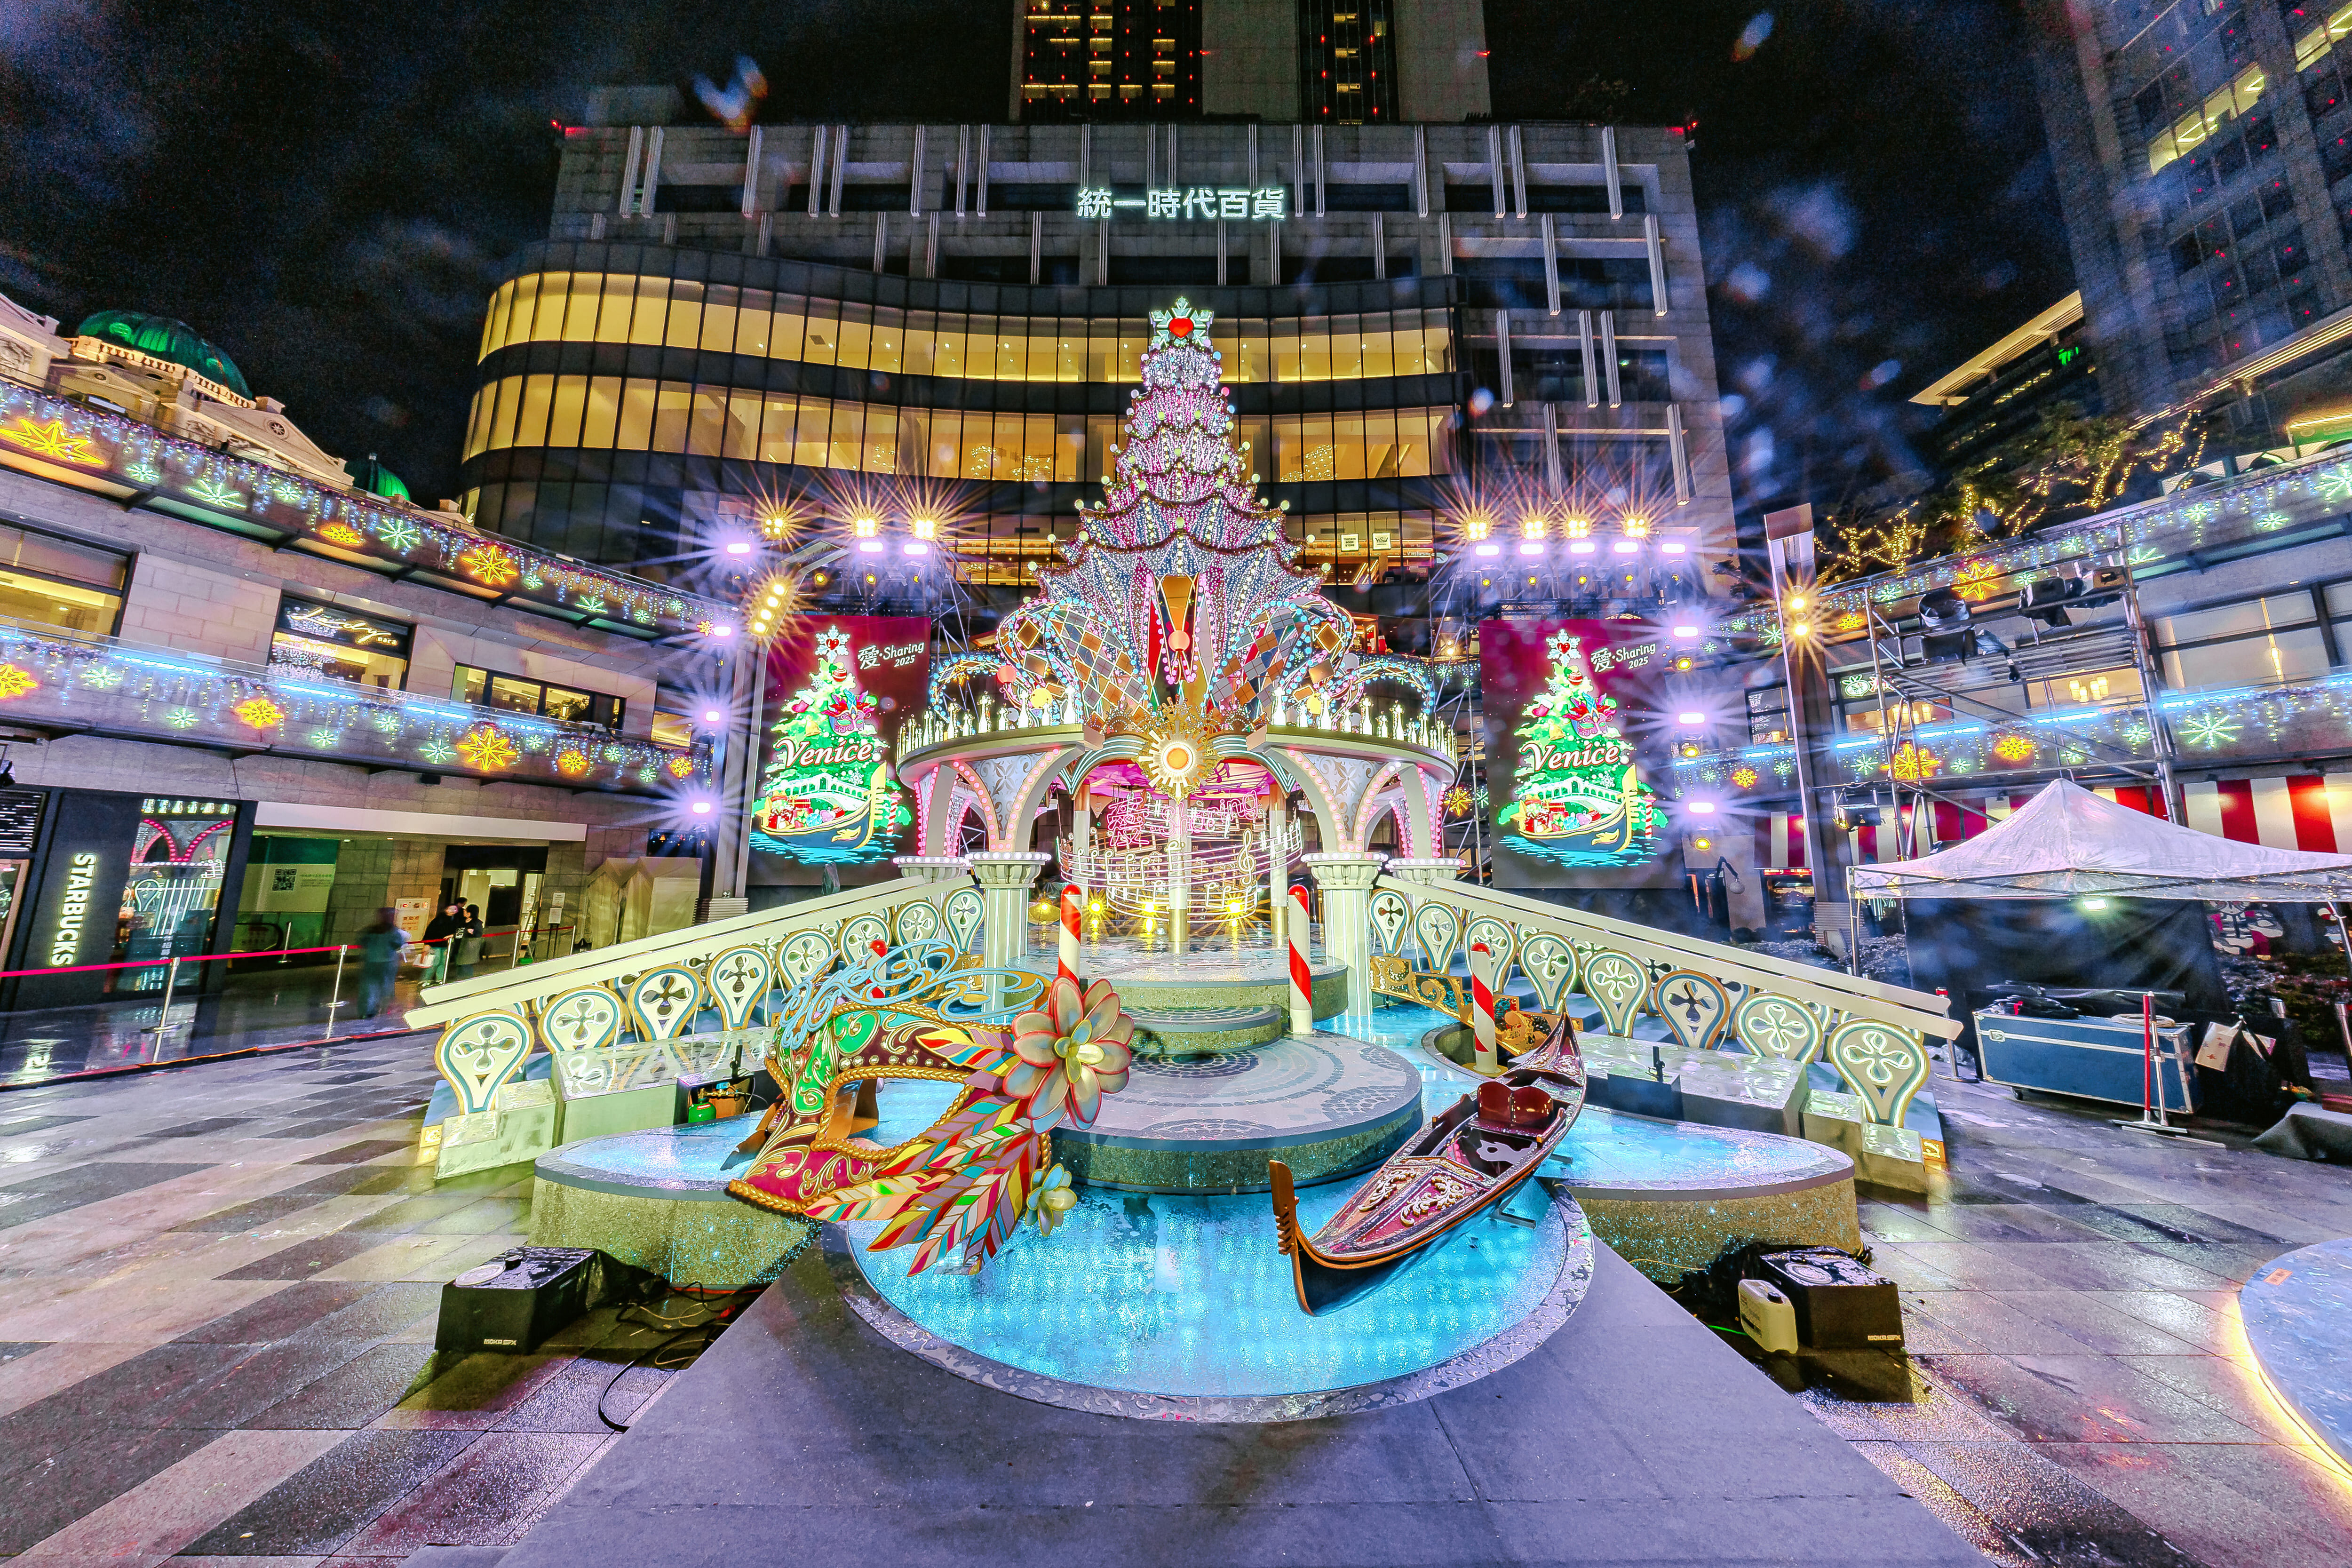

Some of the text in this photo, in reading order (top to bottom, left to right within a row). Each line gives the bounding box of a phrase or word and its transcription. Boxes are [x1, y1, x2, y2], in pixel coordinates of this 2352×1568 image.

[1076, 188, 1285, 219] 統一時代百貨
[377, 637, 397, 645] nara
[894, 654, 916, 668] 2025
[1628, 656, 1649, 670] 2025
[776, 739, 873, 768] Venice
[1521, 743, 1620, 772] Venice
[52, 853, 96, 966] STARBUCKS
